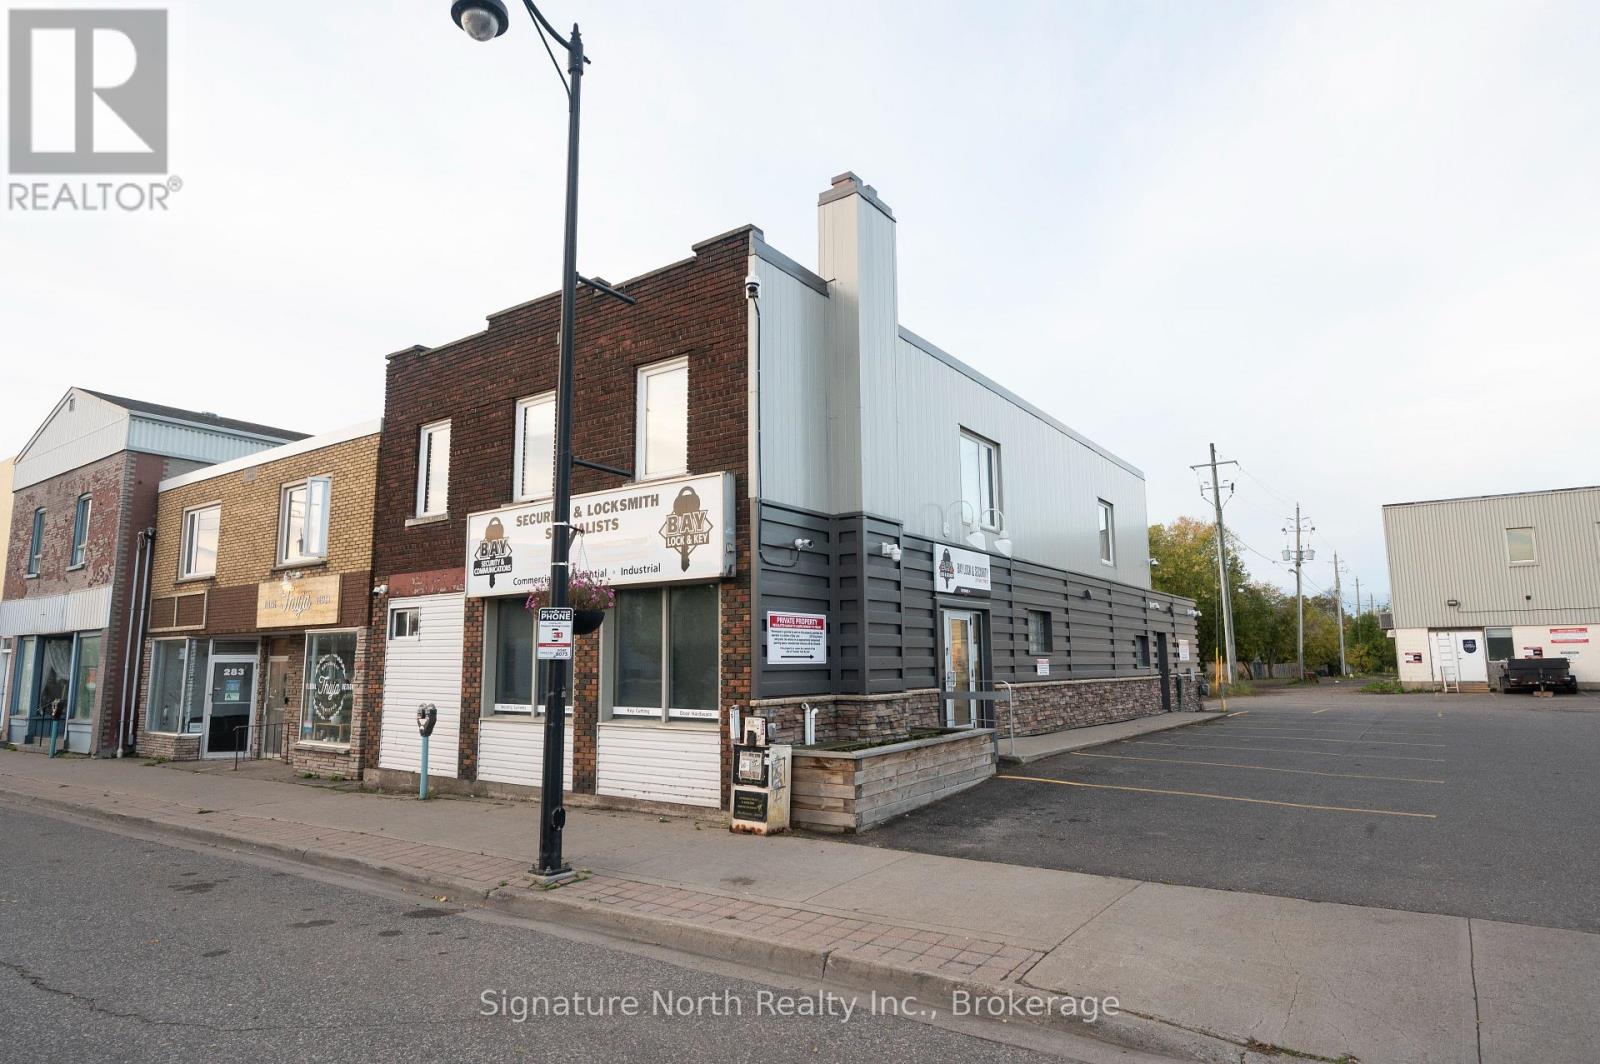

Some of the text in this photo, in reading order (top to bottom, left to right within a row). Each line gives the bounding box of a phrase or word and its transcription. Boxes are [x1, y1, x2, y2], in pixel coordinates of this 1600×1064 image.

[573, 504, 582, 518] &
[587, 493, 659, 517] LOCKSMITH
[666, 510, 706, 534] BAY
[667, 532, 708, 546] LOCK & KEY
[480, 538, 508, 557] BAY
[474, 564, 511, 576] COMMUNICATIONS
[481, 558, 500, 568] SECURITY
[620, 562, 661, 576] Industrial
[776, 616, 818, 626] PRIVATE PROPERTY
[224, 668, 245, 676] 283
